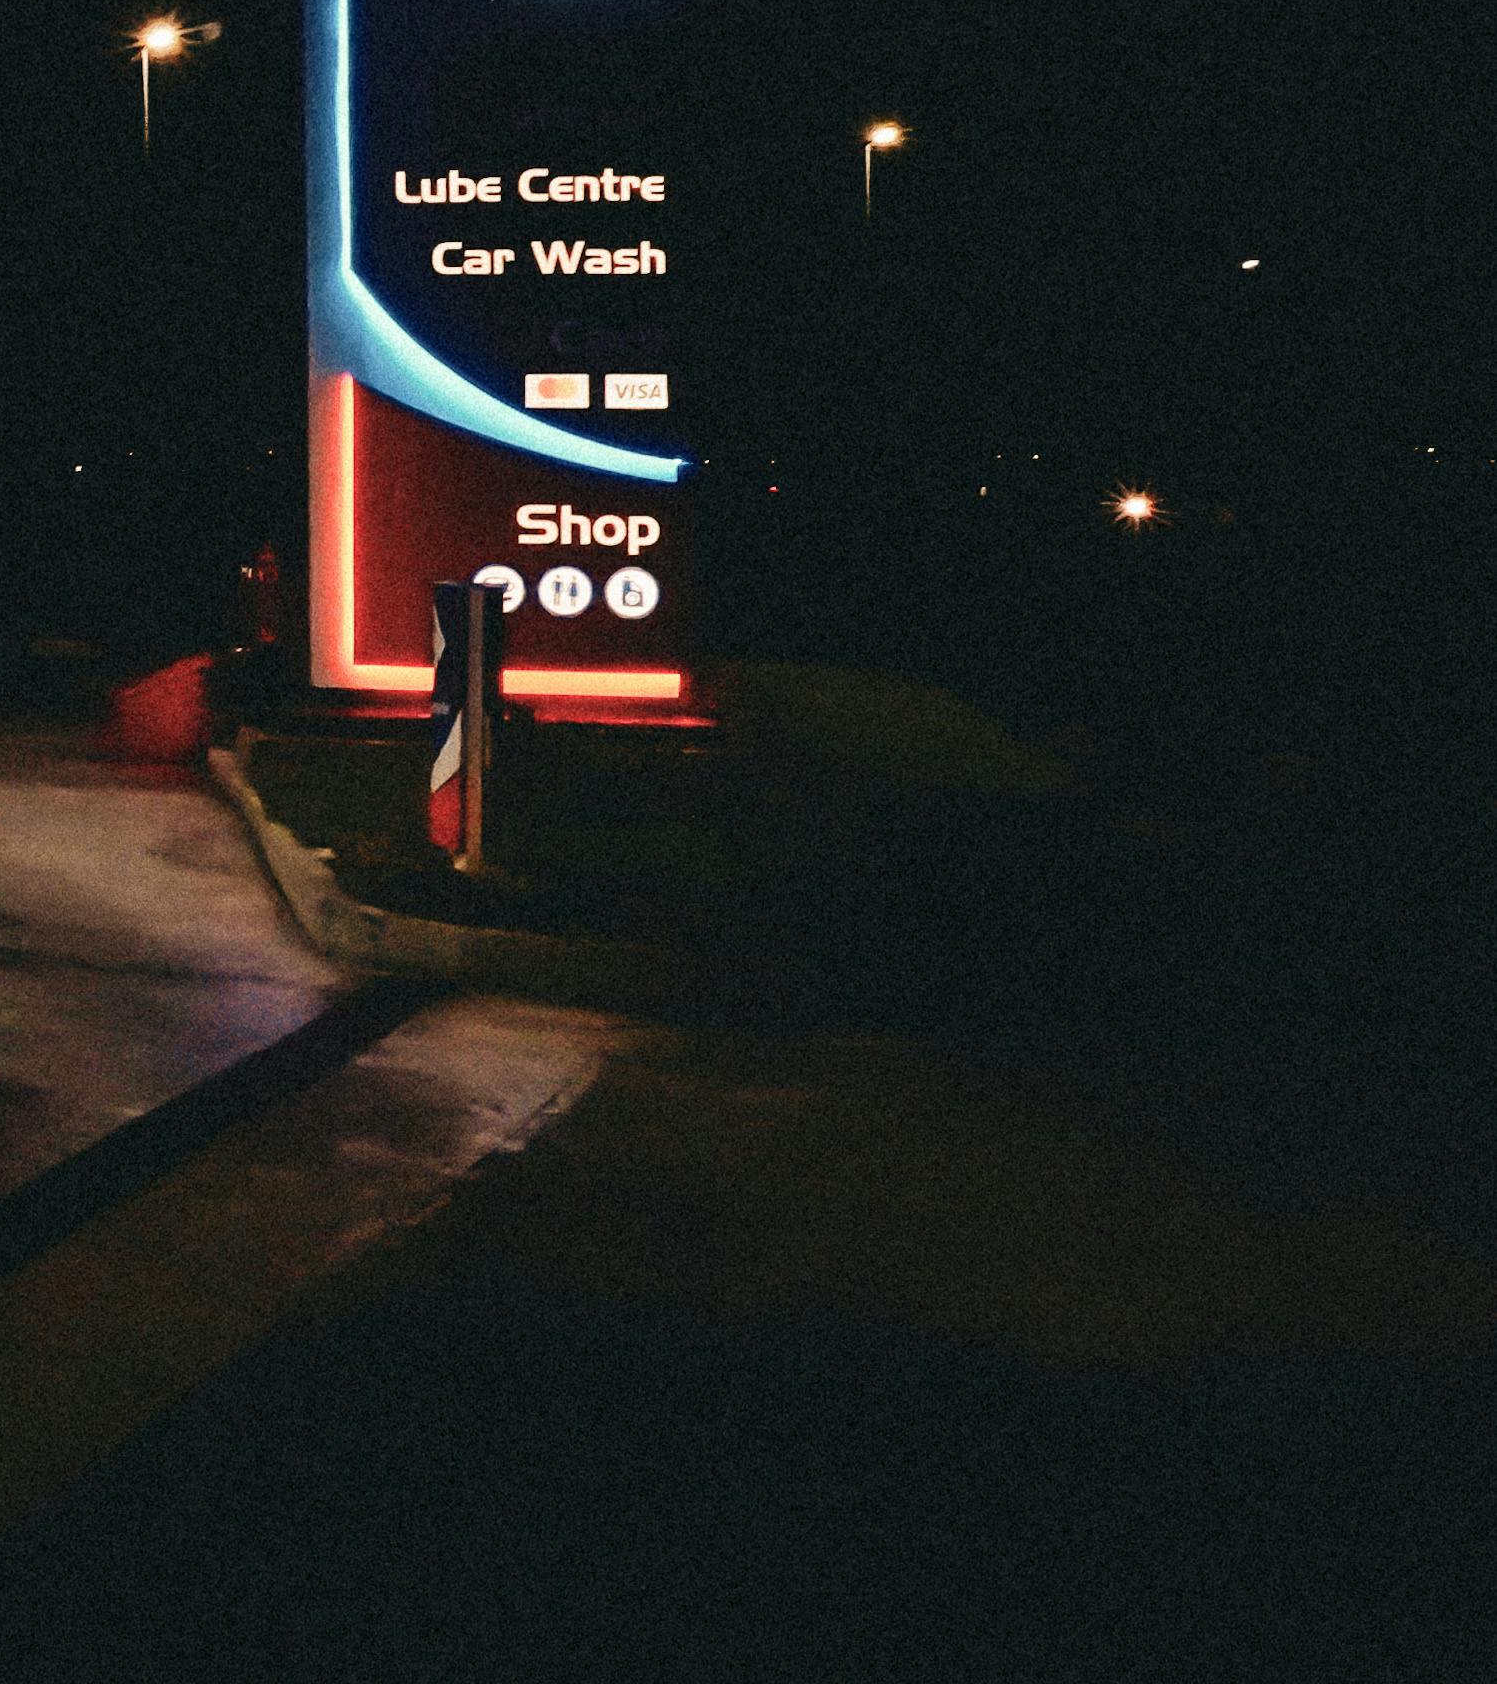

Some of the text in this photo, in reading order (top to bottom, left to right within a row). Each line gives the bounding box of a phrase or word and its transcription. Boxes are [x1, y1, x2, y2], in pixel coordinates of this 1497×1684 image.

[395, 168, 665, 203] Lube Centre
[432, 241, 666, 275] Car Wash
[614, 382, 662, 400] VISA
[516, 504, 660, 555] Shop
